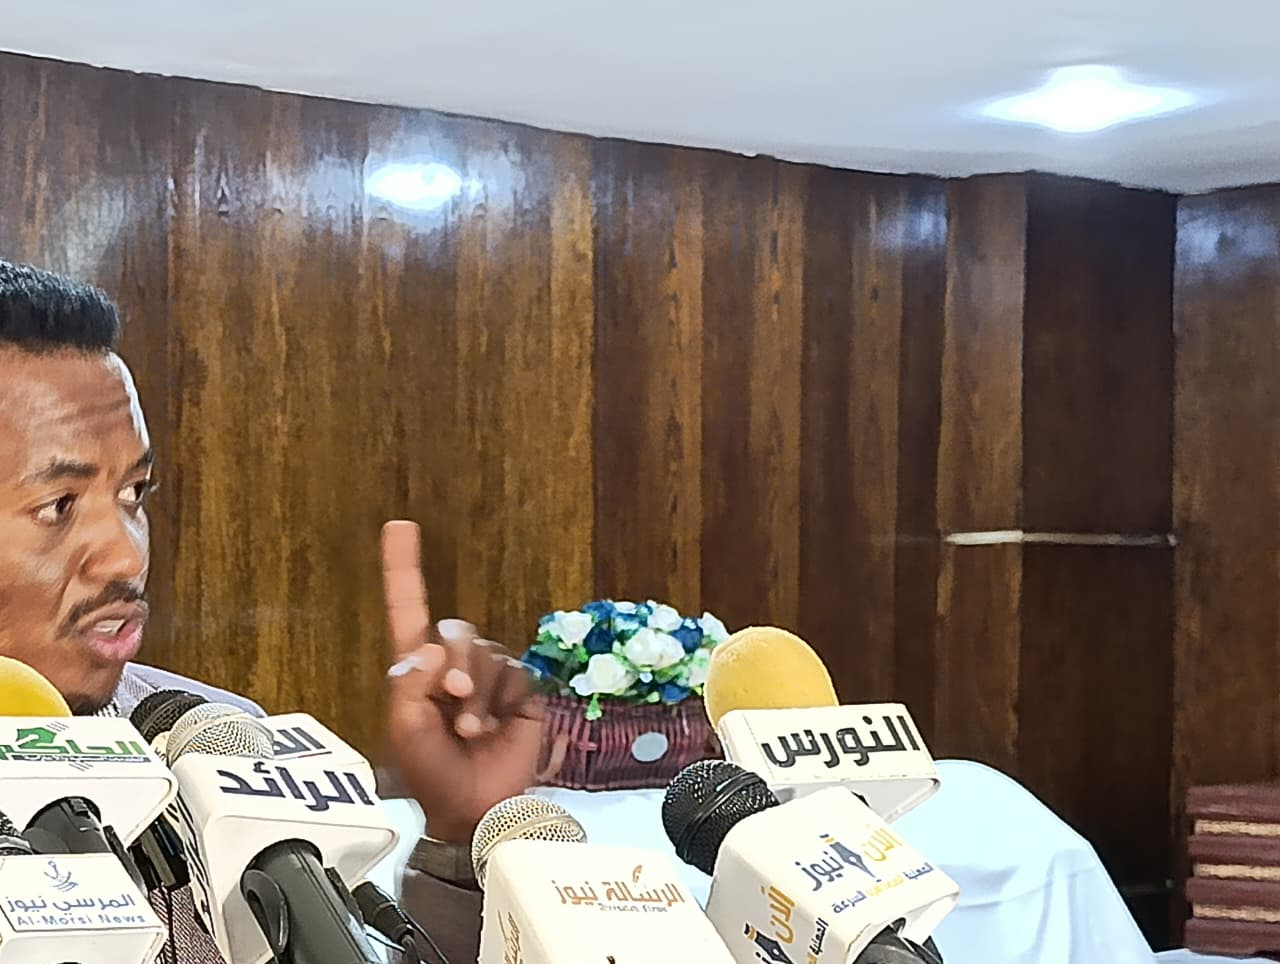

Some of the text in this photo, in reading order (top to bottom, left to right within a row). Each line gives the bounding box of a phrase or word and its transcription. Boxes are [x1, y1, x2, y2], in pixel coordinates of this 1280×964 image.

[761, 715, 921, 768] النورس
[216, 761, 375, 811] الرائد
[794, 851, 845, 892] نيوز
[5, 894, 136, 916] المرسي نيوز
[551, 879, 599, 905] نيوز
[17, 914, 146, 926] Al-Morsi News
